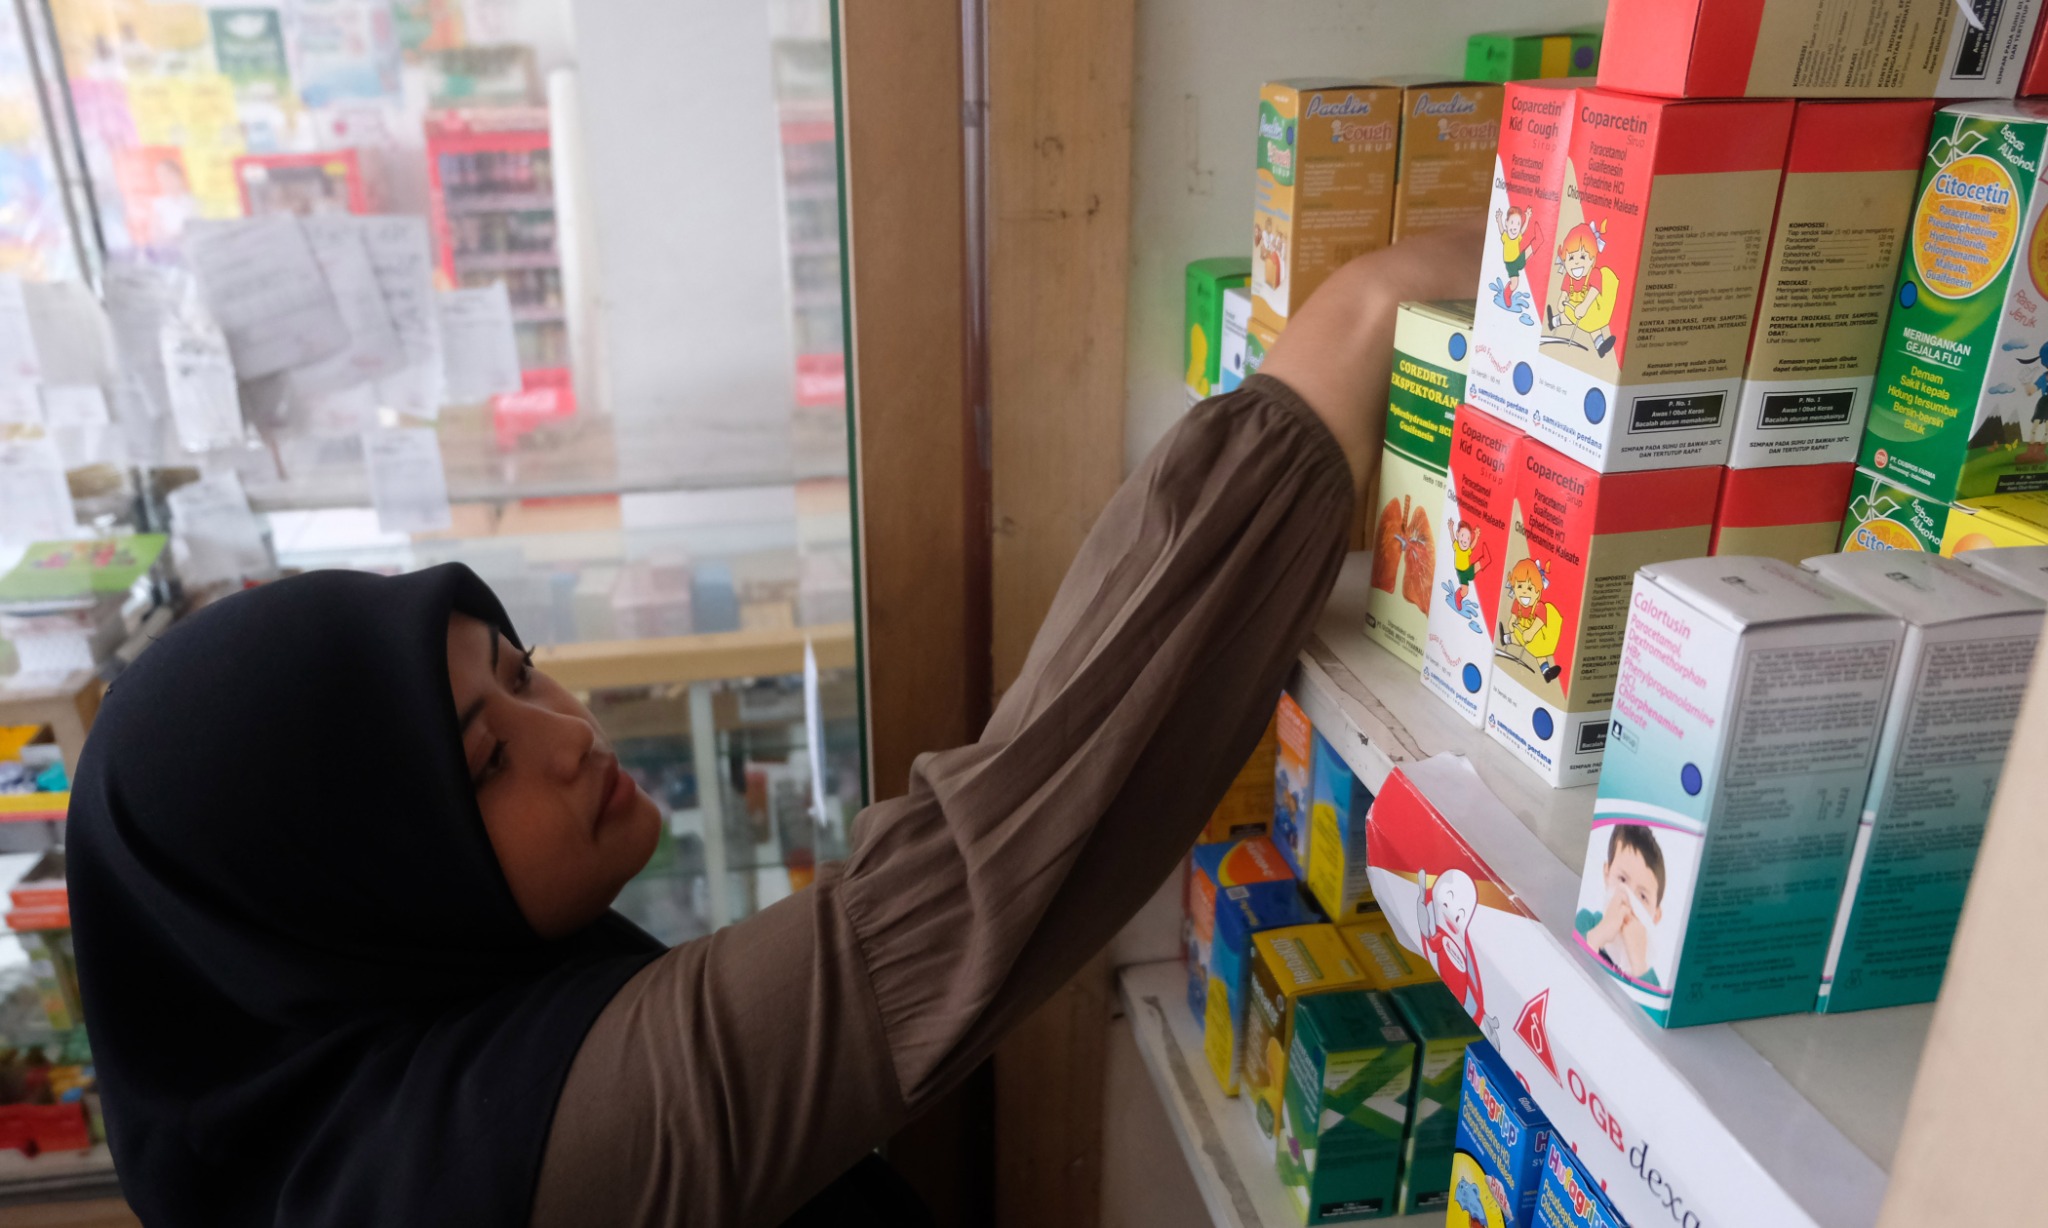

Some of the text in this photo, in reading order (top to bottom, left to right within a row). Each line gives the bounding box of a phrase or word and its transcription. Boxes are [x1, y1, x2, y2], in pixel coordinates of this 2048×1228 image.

[1512, 97, 1562, 116] Coparcetin
[1581, 107, 1648, 134] Coparcetin
[1509, 117, 1558, 139] Kid Cough
[1512, 155, 1544, 170] Paracetamol
[1590, 141, 1627, 161] Paracetamol
[1567, 185, 1639, 216] Chlorphenamine Maleate
[1935, 174, 2011, 206] Citocetin
[1928, 216, 1998, 239] Pseudoephedrine
[1903, 327, 1971, 356] MERINGANKAN
[1906, 341, 1962, 366] GEJALA FLU
[1400, 360, 1449, 388] COREDRYL
[1900, 376, 1950, 400] Sakit kepala
[1911, 366, 1944, 384] Demam
[1887, 385, 1958, 418] Hidung tersumbat
[1893, 401, 1944, 428] Bersin-bersin
[1461, 422, 1507, 454] Coparcetin
[1903, 420, 1926, 435] Batuk
[1459, 439, 1505, 472] Kid Cough
[1461, 474, 1491, 496] Paracetamol
[1480, 467, 1503, 486] Sirup
[1526, 456, 1585, 496] Coparcetin
[1534, 488, 1567, 514] Paracetamol
[1911, 499, 1934, 527] Bebas
[1483, 510, 1506, 531] Maleate
[1909, 516, 1942, 546] Alkoho
[1515, 520, 1580, 566] Chlorphenamine Maleate
[1634, 592, 1691, 640] Calortusin
[1628, 628, 1707, 689] Dextromethorphan
[1623, 656, 1715, 728] Phenylpropanolamine
[1616, 699, 1647, 729] Maleate
[1618, 685, 1684, 740] Chlorphenamine
[1466, 1058, 1517, 1147] Hufagripp
[1567, 1067, 1625, 1153] OGB
[1490, 1178, 1508, 1210] Pilek
